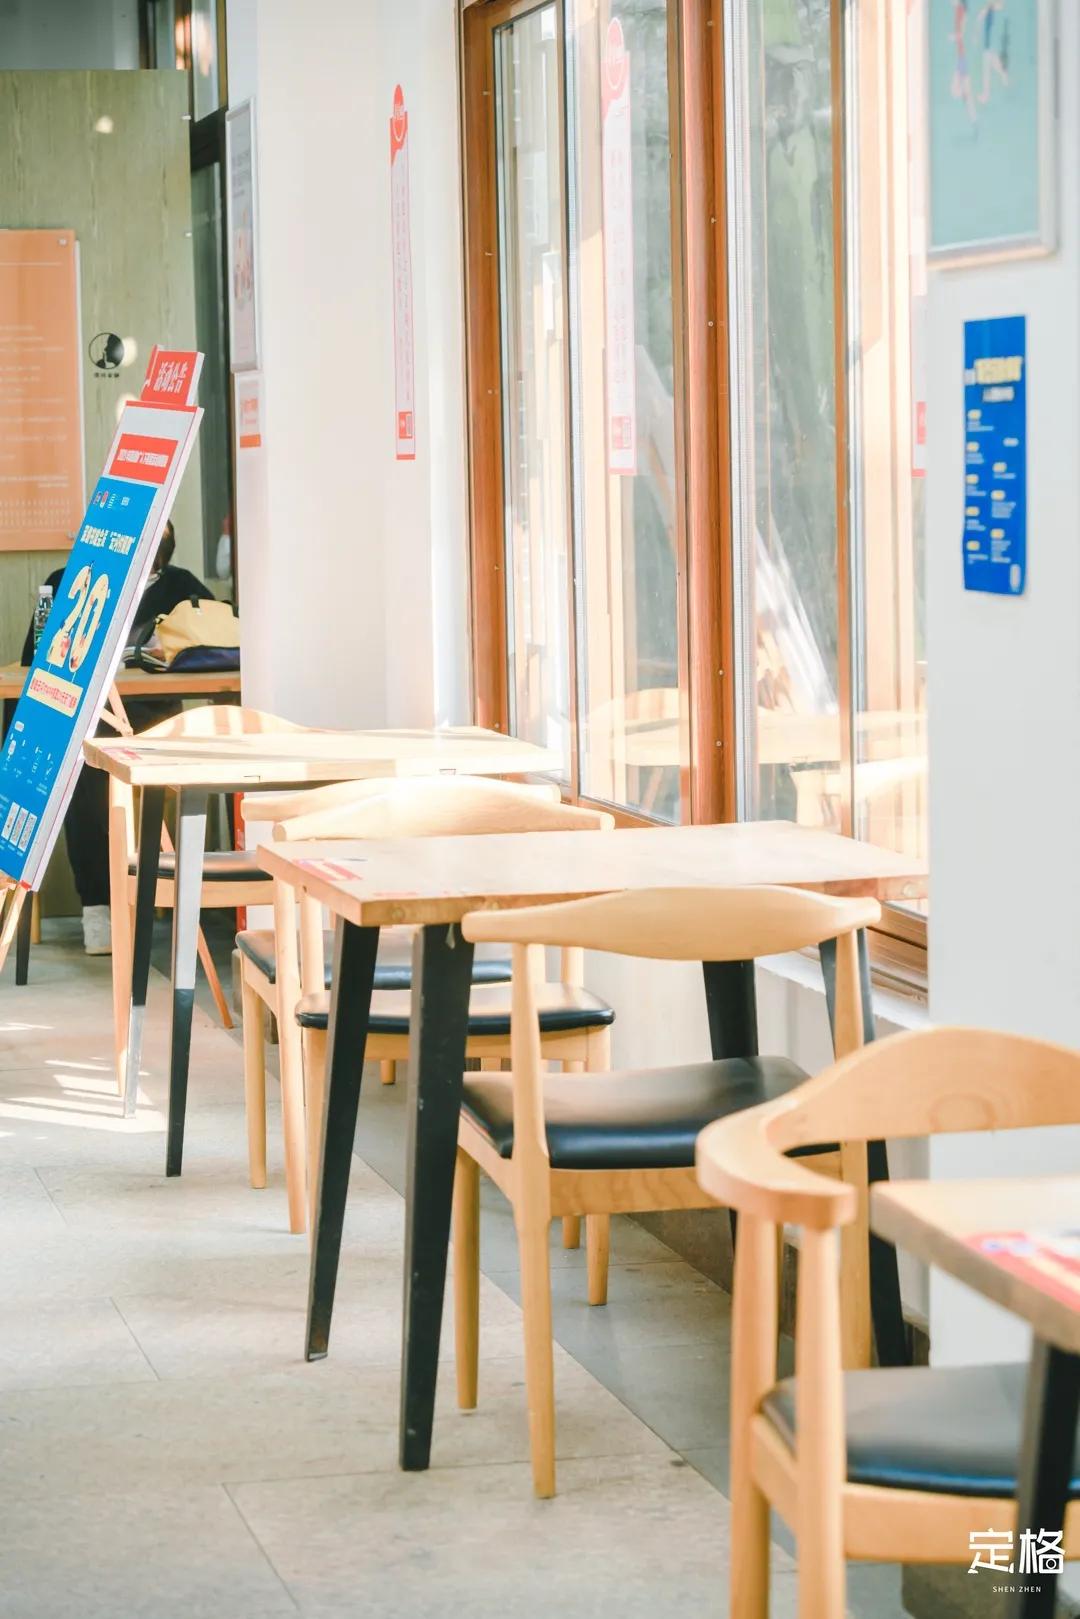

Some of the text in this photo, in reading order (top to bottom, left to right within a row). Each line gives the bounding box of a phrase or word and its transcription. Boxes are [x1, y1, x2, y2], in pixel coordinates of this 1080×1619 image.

[153, 361, 189, 393] 活动公告
[46, 564, 110, 672] 20
